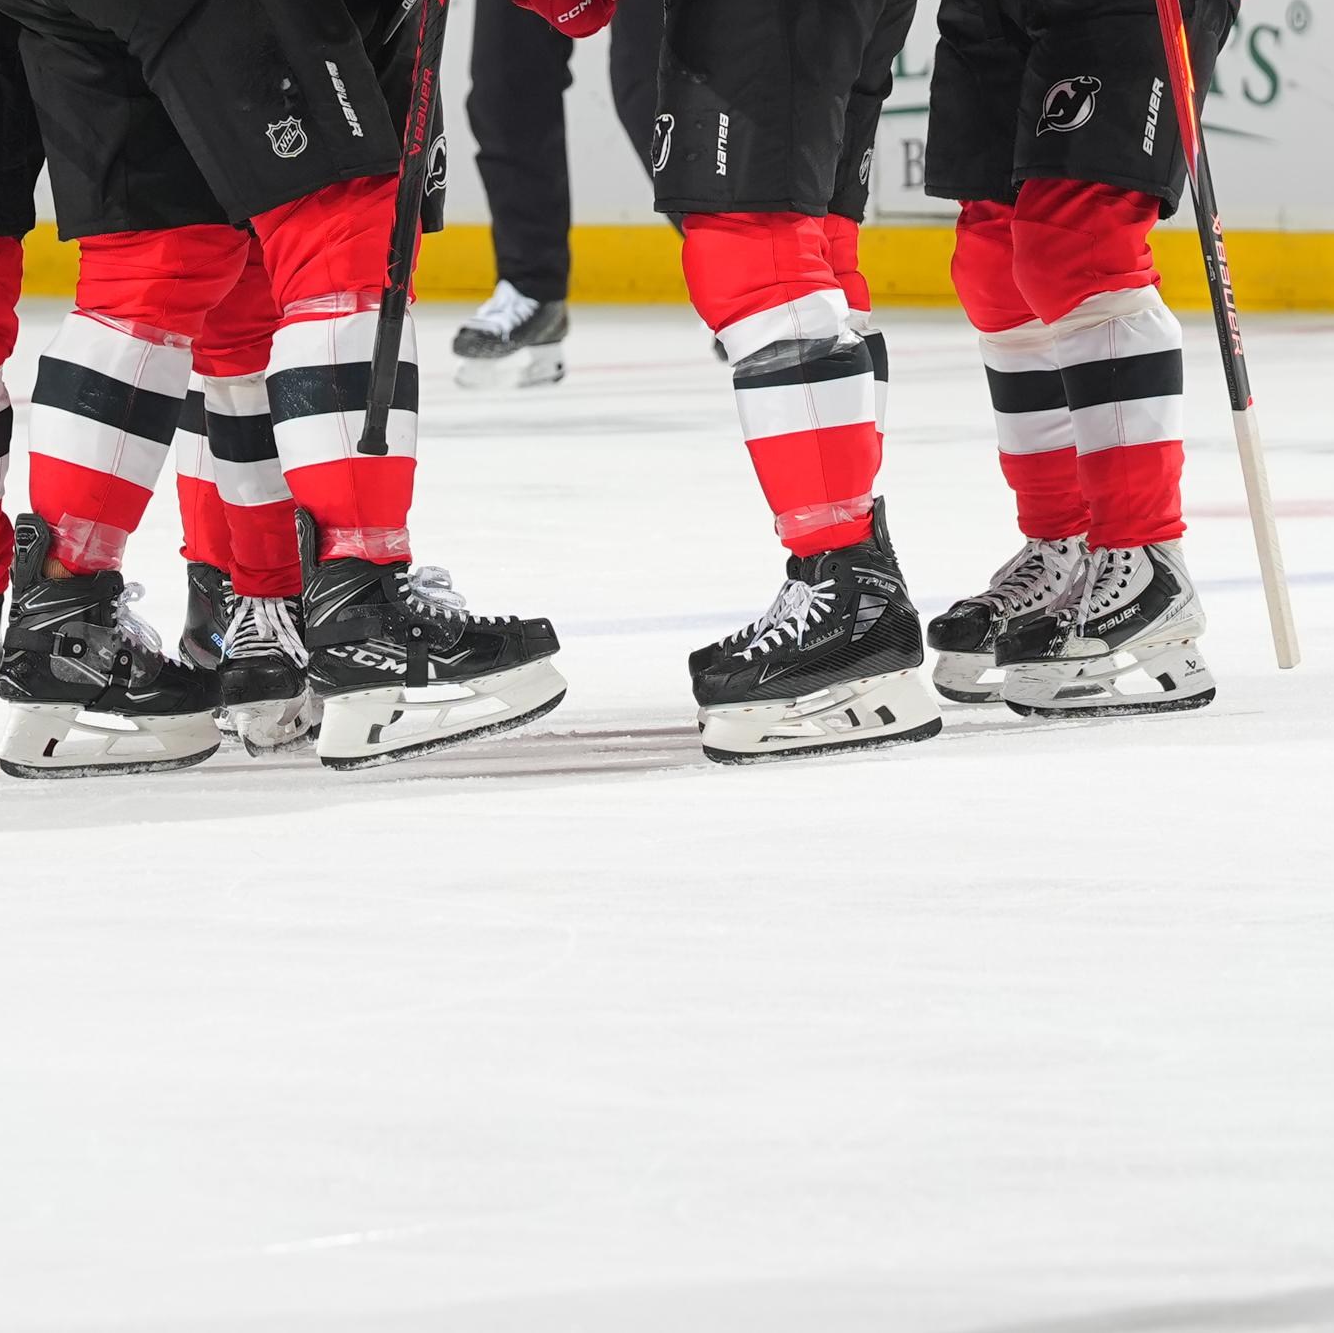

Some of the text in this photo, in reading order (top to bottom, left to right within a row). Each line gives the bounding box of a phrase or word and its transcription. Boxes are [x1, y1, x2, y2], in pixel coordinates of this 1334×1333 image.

[325, 60, 364, 138] BAUER
[414, 67, 434, 143] BAUER
[1142, 76, 1165, 157] BAUER
[716, 112, 730, 177] BAUER
[1214, 240, 1245, 357] BAUER
[854, 574, 898, 594] TRUE
[1097, 602, 1143, 636] BAUER
